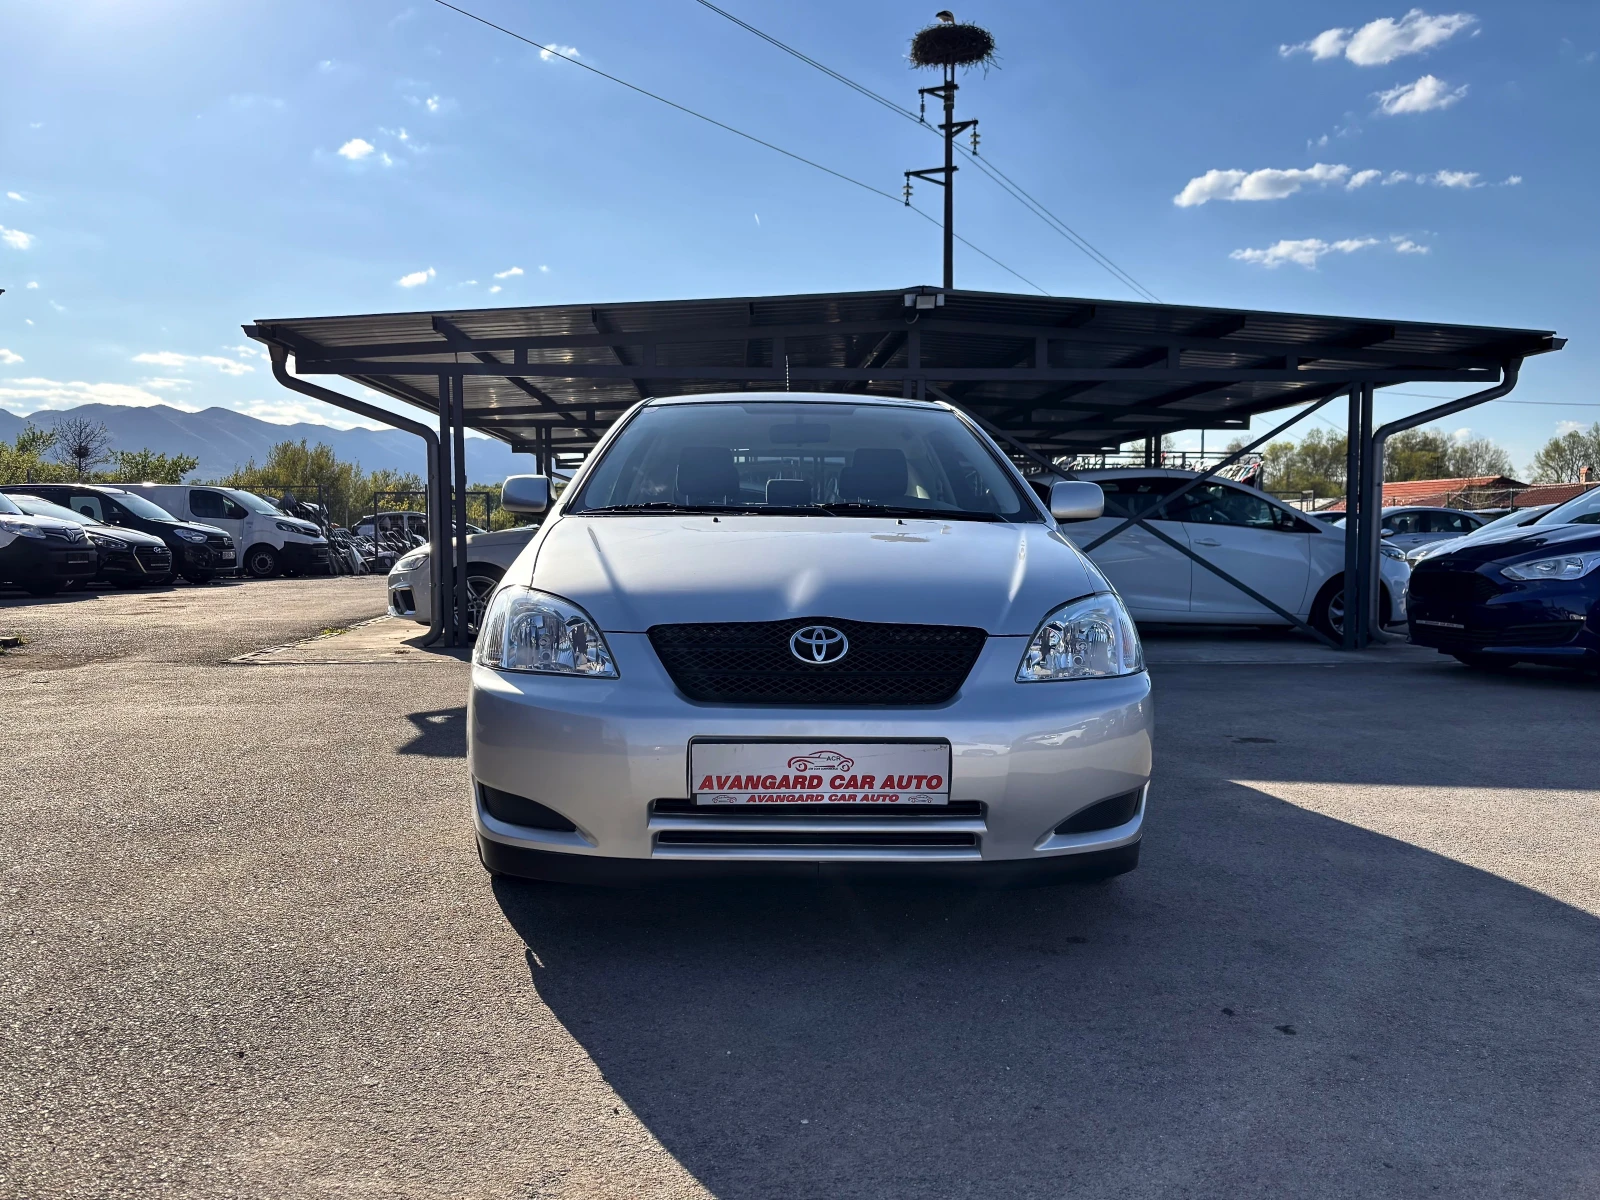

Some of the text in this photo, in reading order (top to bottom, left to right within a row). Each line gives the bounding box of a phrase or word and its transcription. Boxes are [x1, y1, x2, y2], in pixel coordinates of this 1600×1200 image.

[698, 774, 943, 790] AVANGARD CAR AUTO
[746, 794, 899, 803] AVANGARD CAR AUTO
